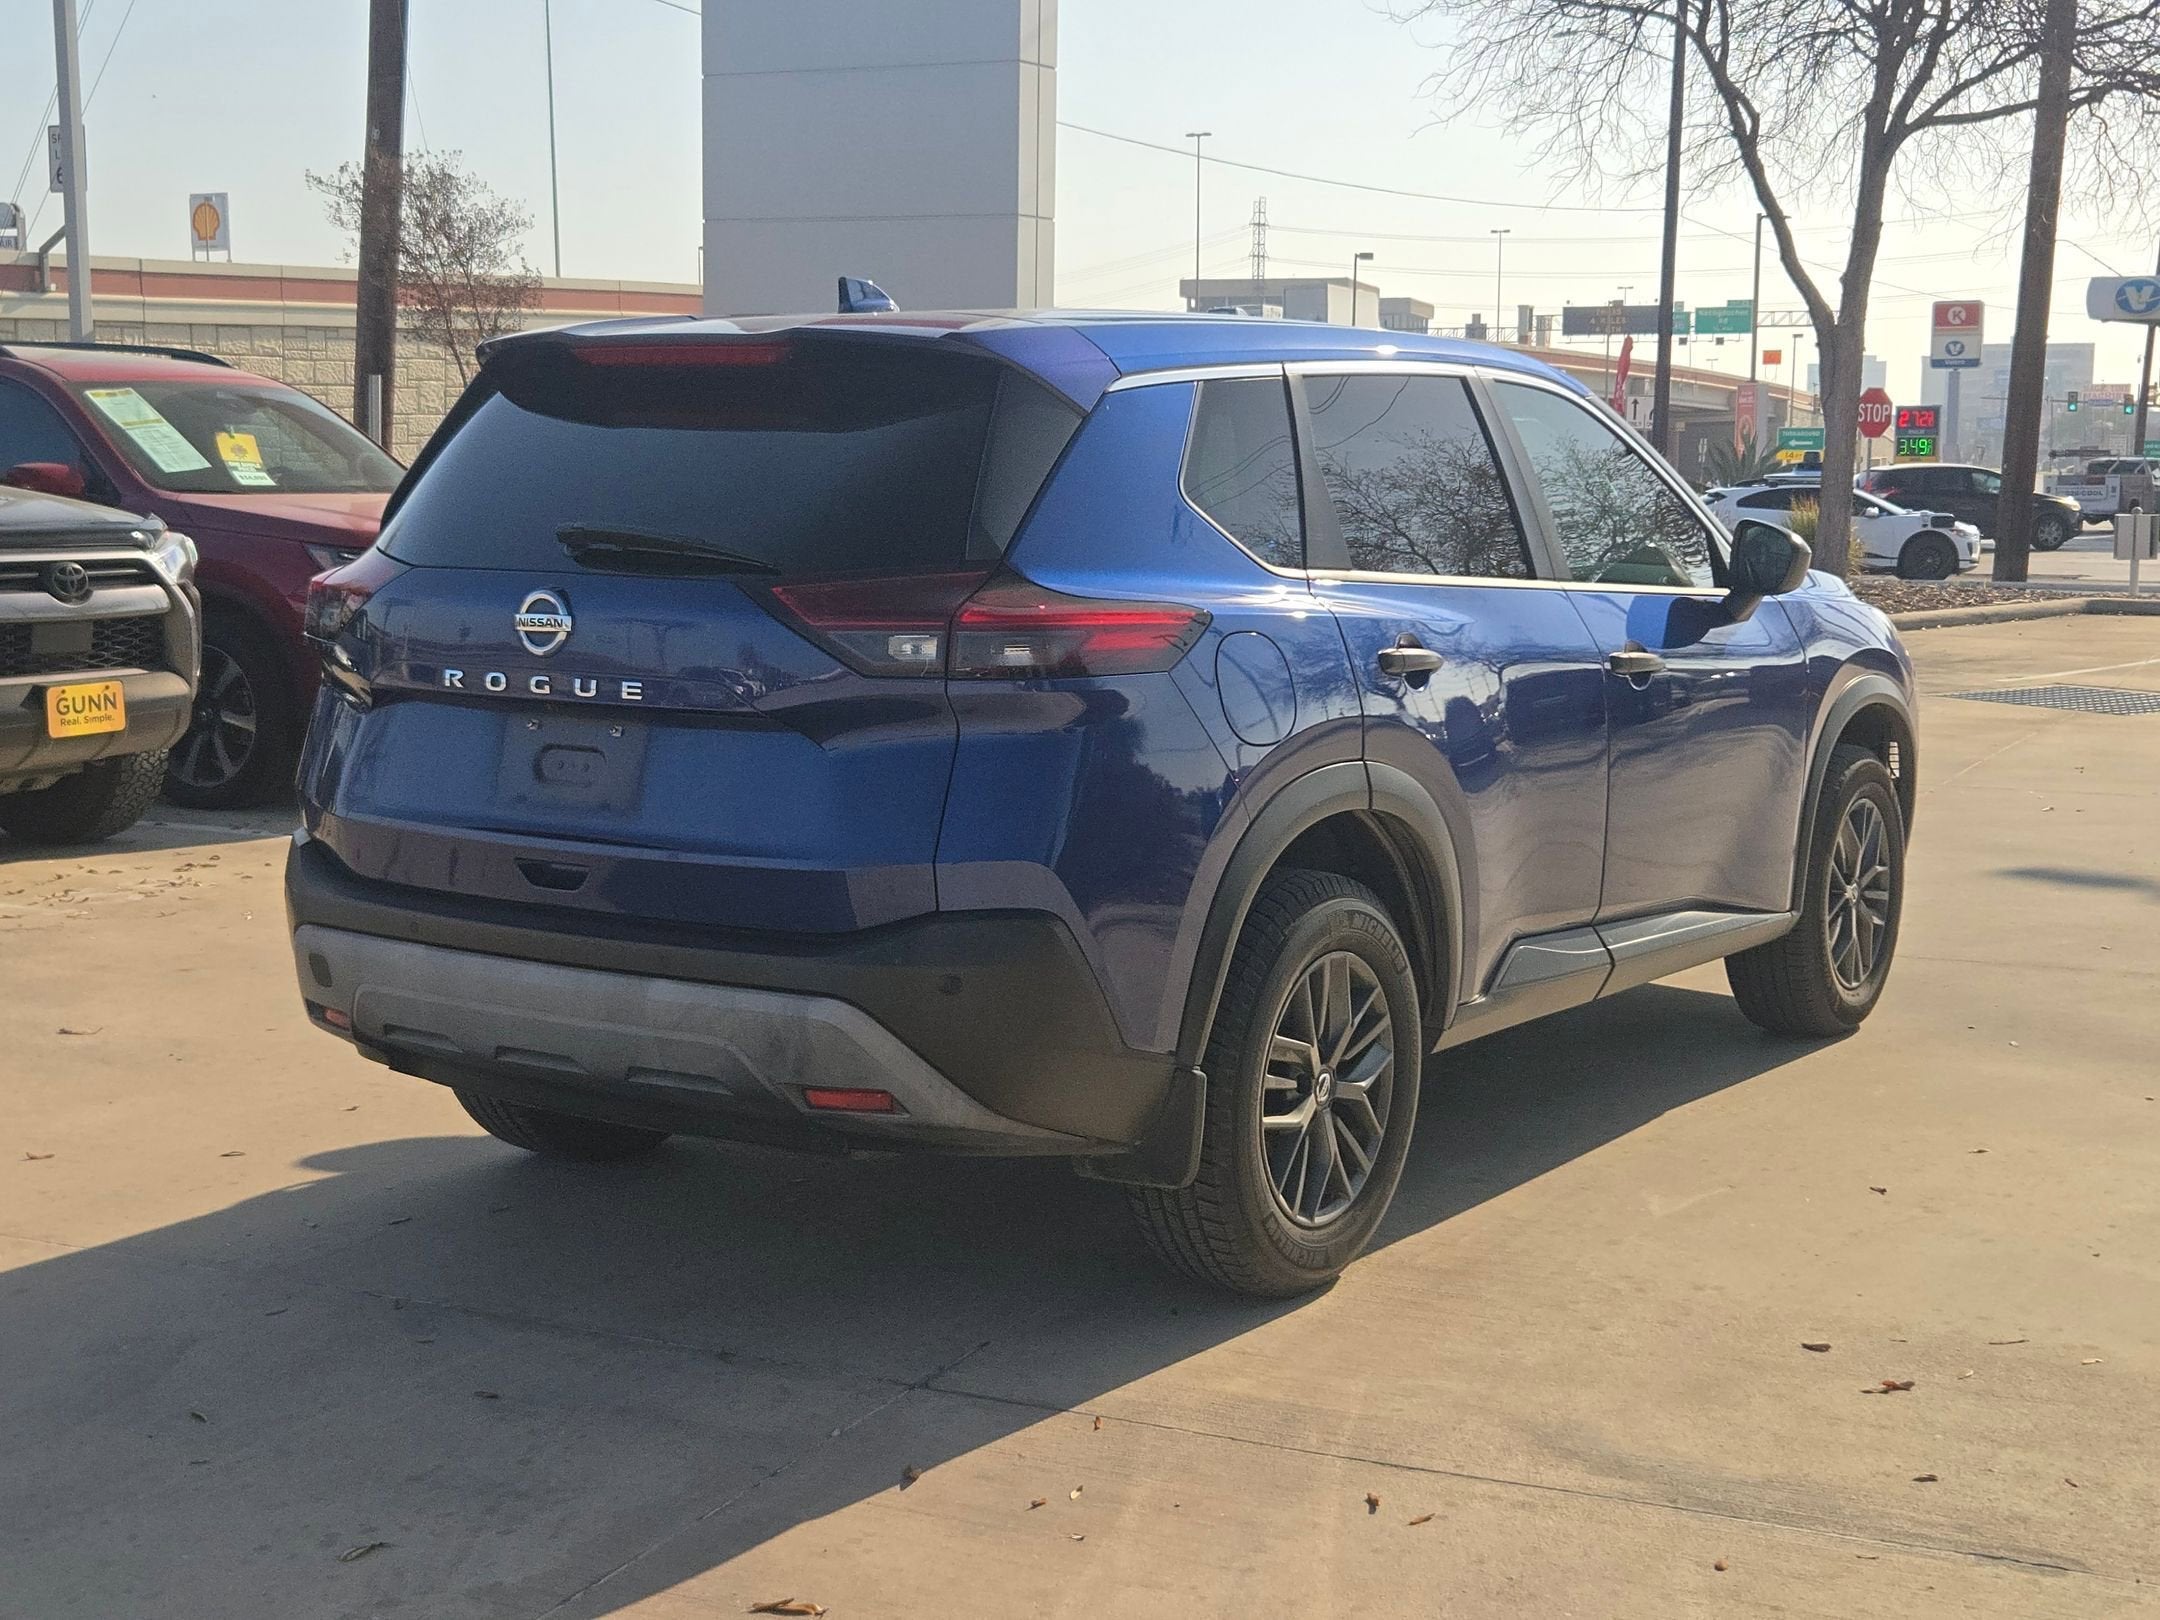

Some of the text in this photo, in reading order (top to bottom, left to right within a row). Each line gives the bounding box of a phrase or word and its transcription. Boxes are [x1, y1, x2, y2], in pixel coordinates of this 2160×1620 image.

[1951, 310, 1964, 322] K
[1858, 403, 1891, 423] STOP
[518, 617, 564, 629] NISSAN
[443, 668, 644, 701] ROGUE
[56, 691, 118, 716] GUNN
[60, 713, 115, 727] Real. Simple.
